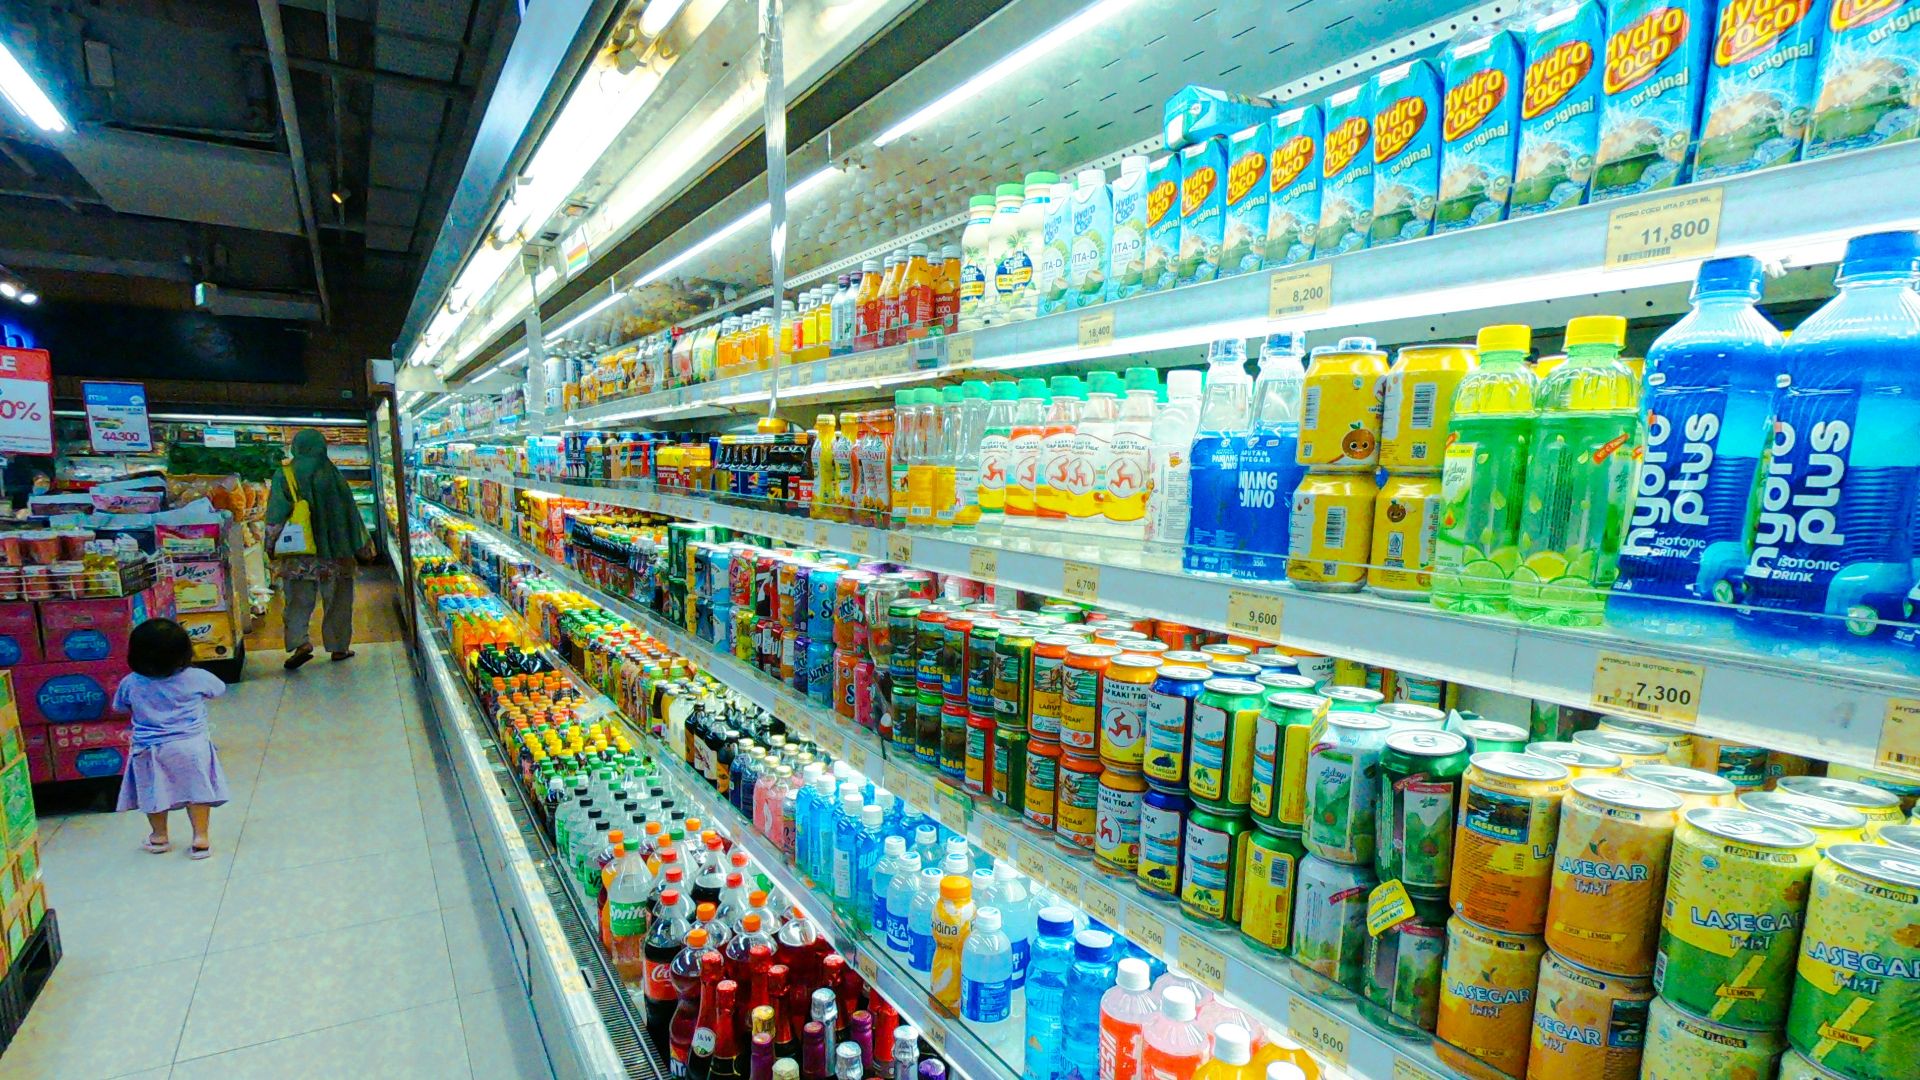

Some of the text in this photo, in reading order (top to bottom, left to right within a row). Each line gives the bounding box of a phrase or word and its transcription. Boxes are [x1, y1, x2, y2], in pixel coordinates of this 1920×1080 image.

[1748, 37, 1814, 80] original
[1630, 67, 1689, 107] original
[1543, 96, 1594, 132] original
[1463, 120, 1509, 153] original
[1390, 144, 1432, 175] original
[1183, 167, 1215, 193] ydro
[1335, 162, 1372, 189] original
[1148, 181, 1177, 207] ydro
[1282, 179, 1317, 204] original
[1148, 199, 1171, 226] oco
[1641, 218, 1710, 246] 11,800
[1293, 286, 1323, 304] 8,200
[1669, 412, 1720, 526] plus
[1793, 420, 1851, 546] plus
[1777, 557, 1841, 571] ISOTONIC
[1772, 569, 1814, 583] DRINK
[1249, 610, 1277, 625] 9,600
[1111, 689, 1130, 699] KAKI
[1132, 692, 1149, 700] TIG
[1150, 700, 1162, 710] IGA
[1636, 682, 1691, 705] 7,300
[1039, 703, 1061, 712] LARUT
[1113, 796, 1134, 808] TIGA
[1470, 818, 1519, 837] LASEGAR
[1558, 857, 1649, 881] ASEGAR
[1867, 885, 1915, 904] FLAVOUR
[610, 904, 647, 921] Sprite
[1141, 926, 1162, 945] 7,500
[1197, 957, 1221, 980] 7,300
[1726, 987, 1756, 998] LEMON
[1312, 1026, 1344, 1053] 9,600
[1538, 1015, 1601, 1046] SEGAR
[1827, 1027, 1860, 1045] LEMON
